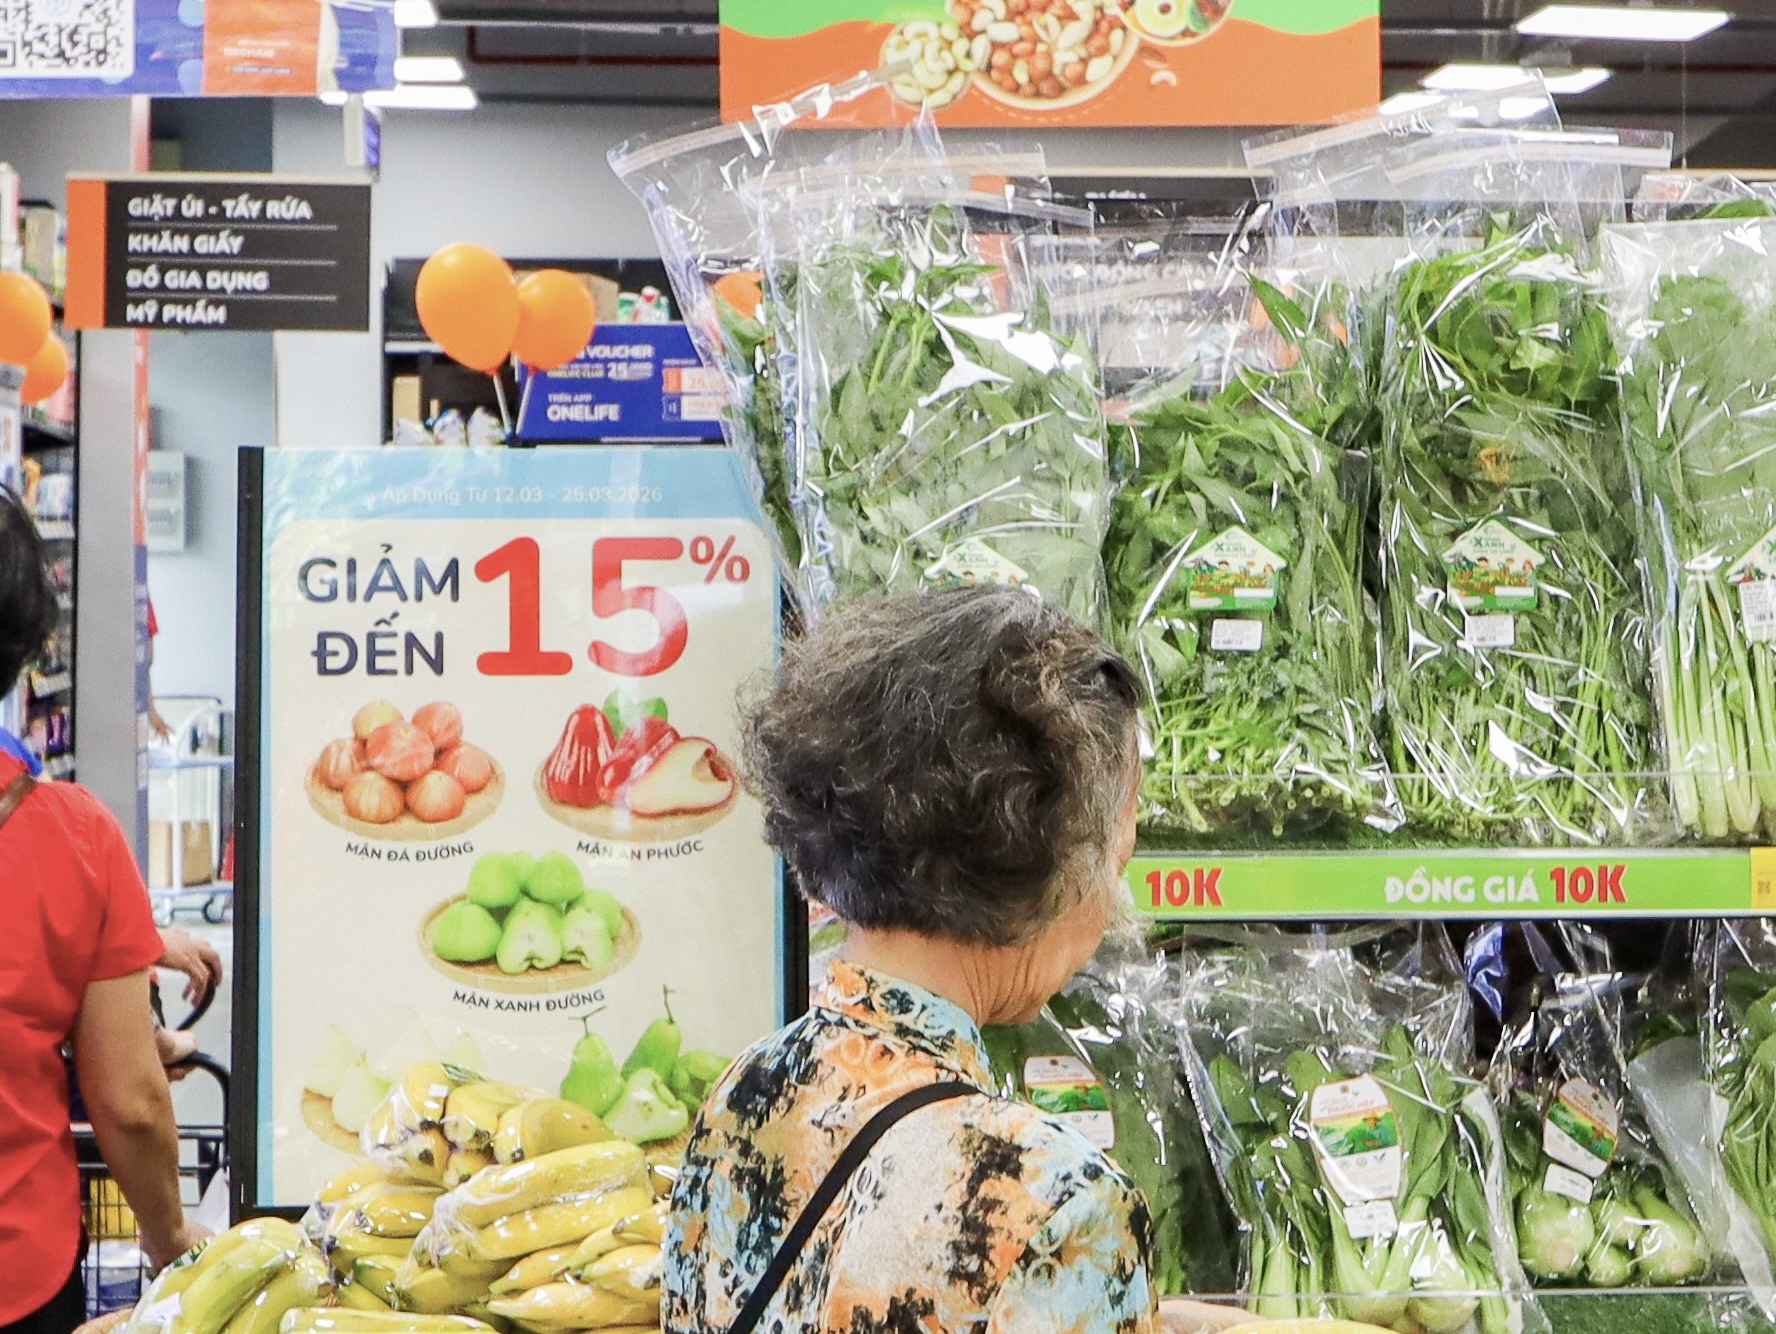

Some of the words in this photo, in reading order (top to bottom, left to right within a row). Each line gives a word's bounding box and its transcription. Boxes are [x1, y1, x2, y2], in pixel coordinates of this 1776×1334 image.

[164, 269, 204, 290] GIA
[297, 544, 461, 604] GIẢM
[474, 535, 750, 677] 15%
[310, 610, 446, 677] ĐẾN
[345, 841, 382, 861] MẬN
[387, 844, 410, 863] ĐÁ
[1145, 867, 1225, 908] 10K
[1383, 866, 1475, 904] ĐỒNG
[1482, 867, 1540, 904] GIÁ
[1549, 864, 1627, 904] 10K
[452, 989, 491, 1010] MẬN
[494, 998, 541, 1013] XANH
